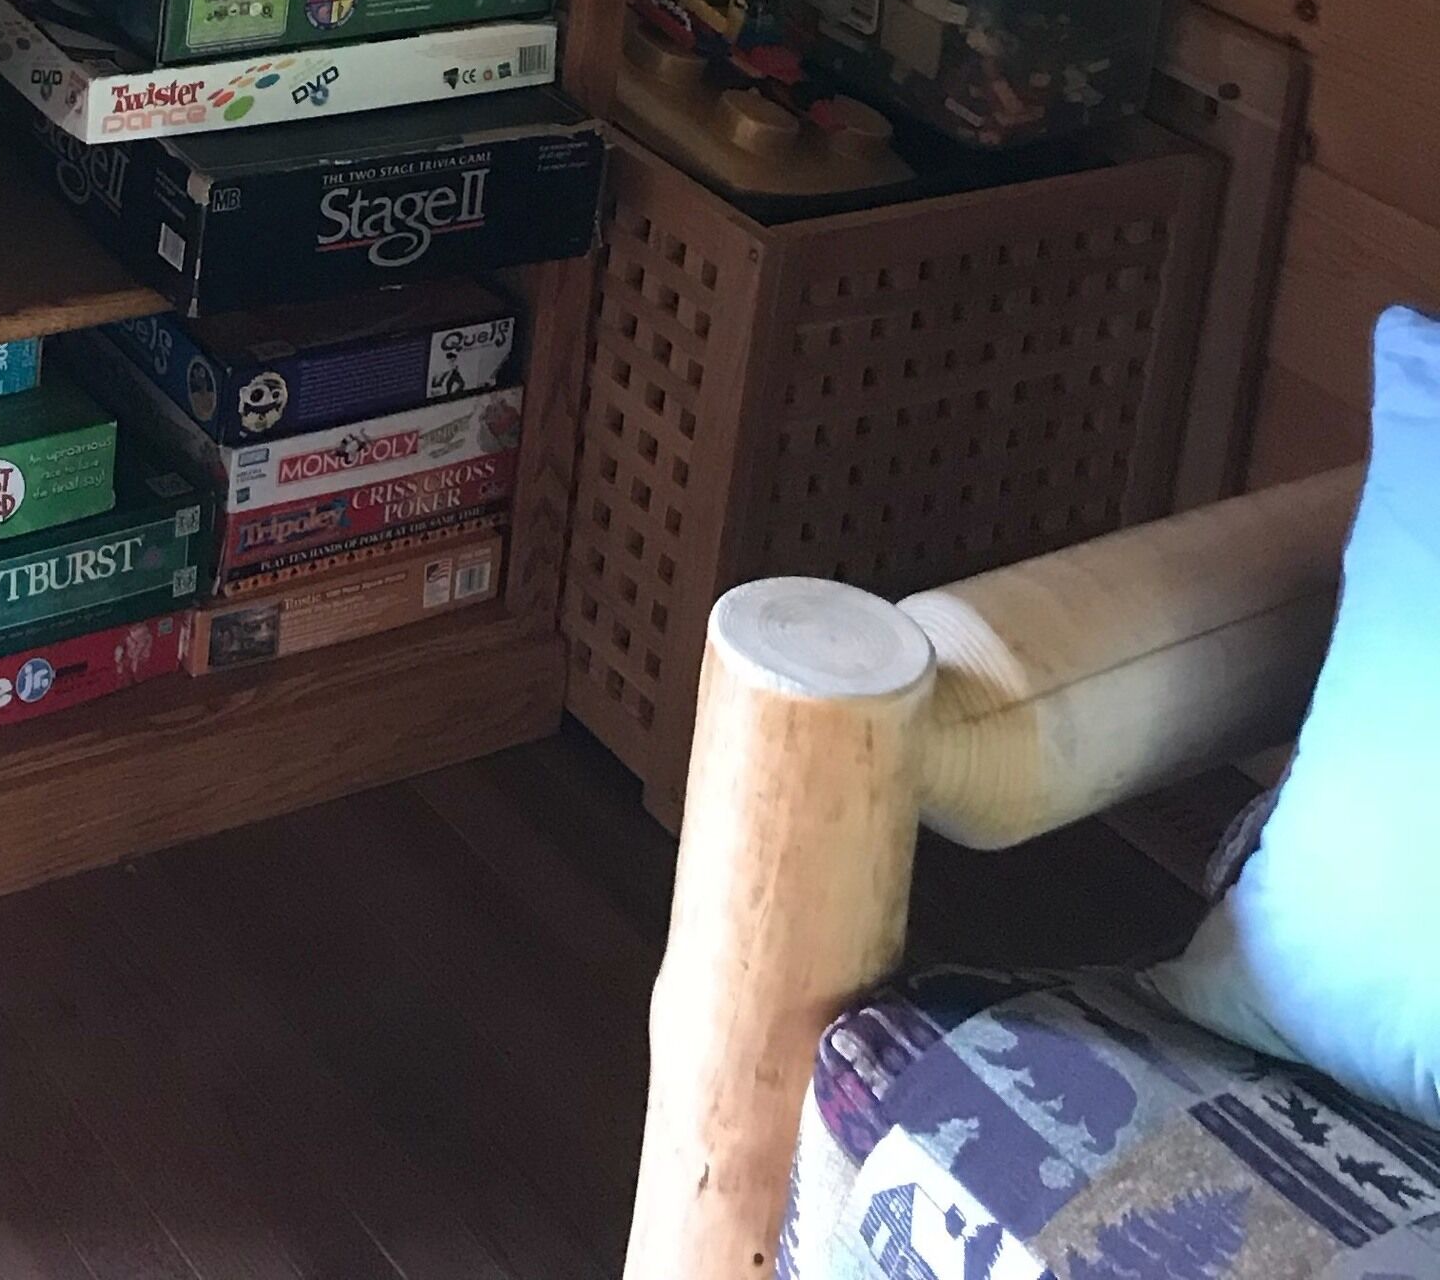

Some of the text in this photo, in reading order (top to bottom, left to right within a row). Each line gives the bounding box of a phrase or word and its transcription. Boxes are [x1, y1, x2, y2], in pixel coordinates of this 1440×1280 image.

[110, 78, 206, 115] Twister
[291, 65, 340, 104] DVD
[322, 151, 493, 186] THE TWO STAGE TRIVIA GAME
[211, 187, 242, 213] MB
[316, 168, 491, 267] Stage II
[440, 319, 511, 353] Quelf
[46, 436, 114, 462] uproarious
[279, 433, 417, 482] MONOPOLY
[51, 477, 80, 494] final
[351, 460, 497, 510] CRISS CROSS
[383, 490, 462, 523] POKER
[19, 664, 52, 698] jr.
